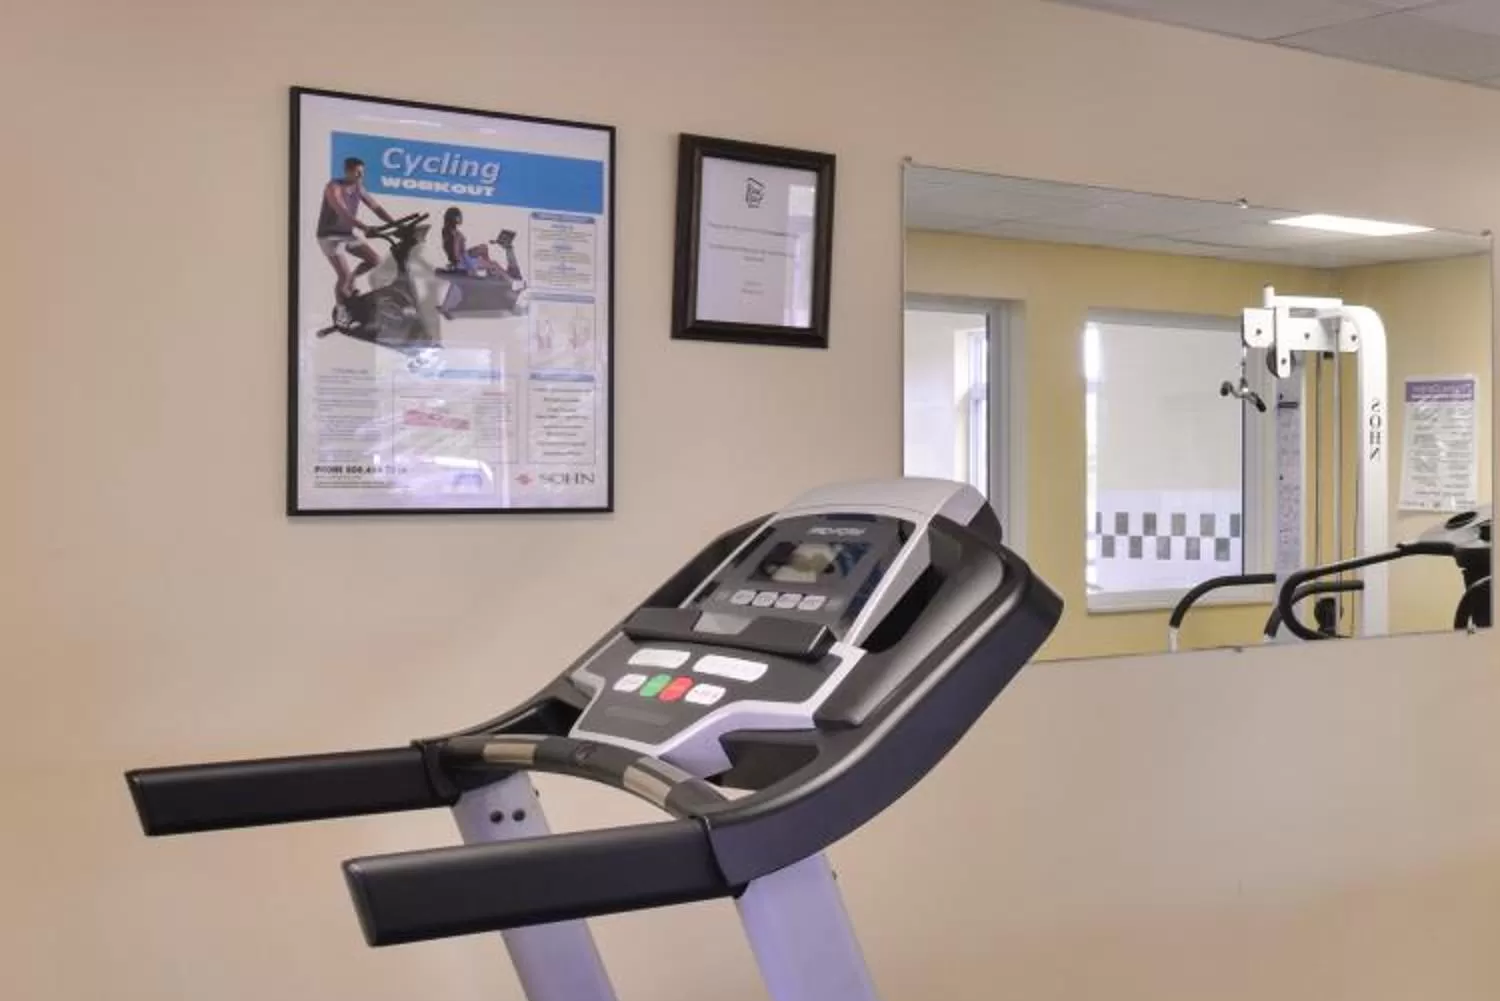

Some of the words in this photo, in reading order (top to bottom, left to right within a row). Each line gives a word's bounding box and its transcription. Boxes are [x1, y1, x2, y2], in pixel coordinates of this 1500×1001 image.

[382, 146, 501, 184] Cycling
[381, 175, 495, 197] WORKOUT
[538, 471, 595, 485] SOHN
